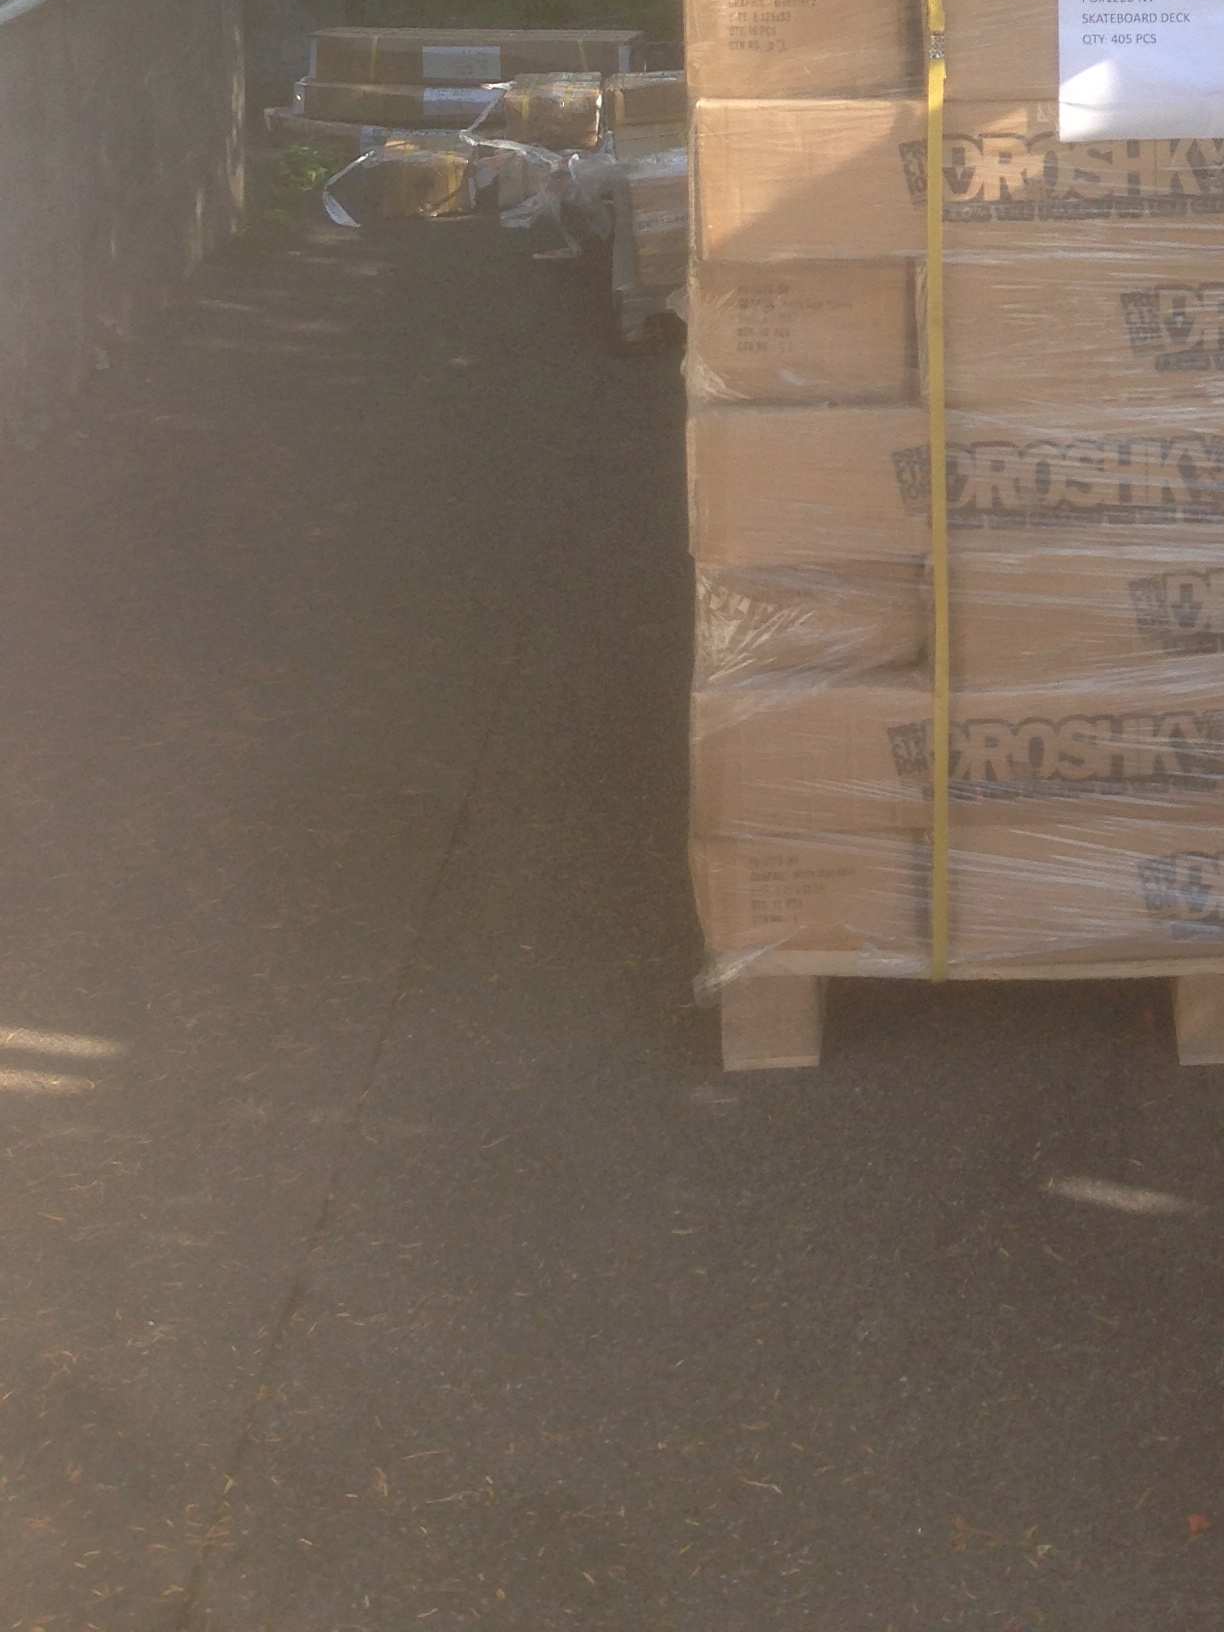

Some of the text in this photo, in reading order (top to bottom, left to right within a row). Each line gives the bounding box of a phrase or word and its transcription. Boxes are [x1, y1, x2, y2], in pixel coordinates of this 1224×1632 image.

[1081, 11, 1192, 24] SKATEBOARD DECK
[1111, 33, 1133, 44] 405
[1136, 33, 1158, 44] PCS
